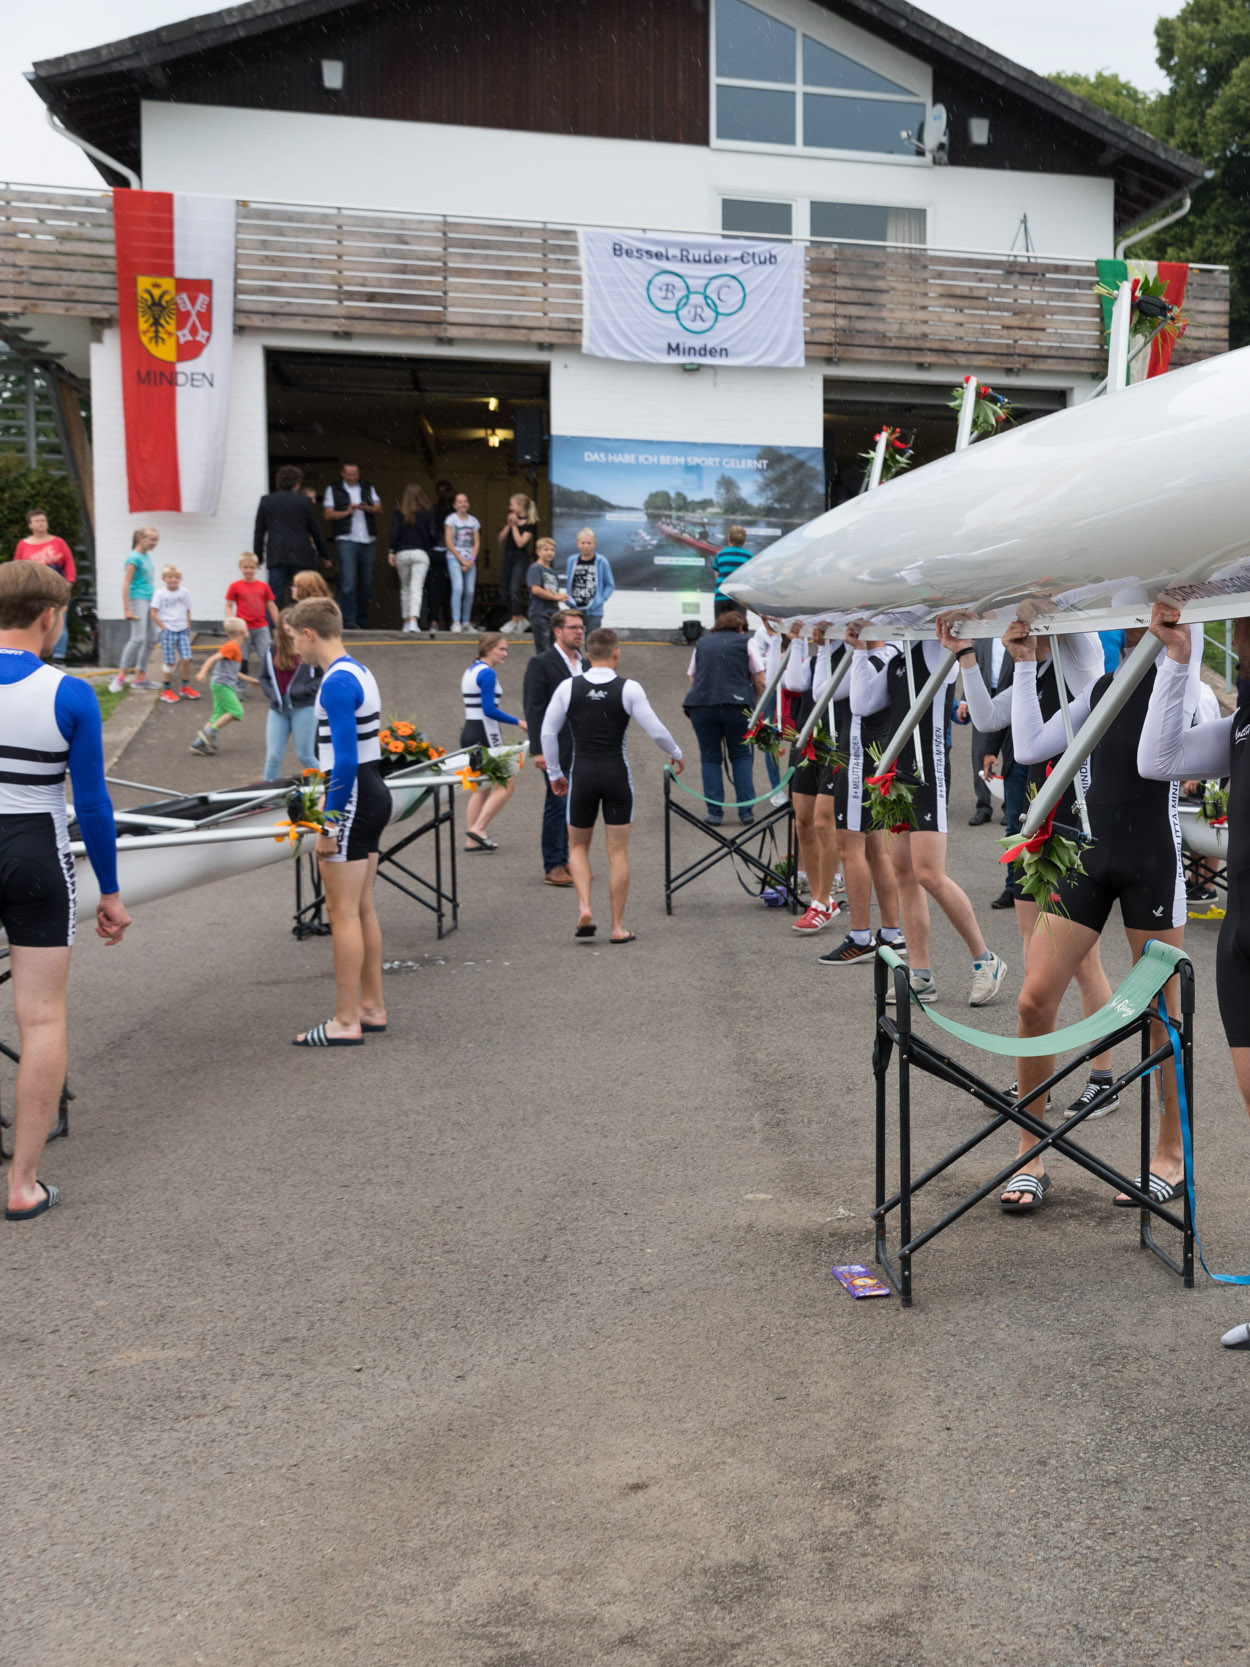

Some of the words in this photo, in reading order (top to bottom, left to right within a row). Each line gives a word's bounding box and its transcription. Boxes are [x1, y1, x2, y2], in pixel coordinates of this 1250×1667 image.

[612, 242, 778, 265] Bessel-Ruder-Club
[667, 342, 729, 358] Minden
[136, 370, 214, 388] MINDEN
[584, 451, 606, 463] DAS
[608, 453, 637, 464] HABE
[638, 454, 659, 465] ICH
[660, 454, 685, 466] BEIM
[687, 456, 720, 467] SPORT
[722, 457, 769, 470] GELERNT
